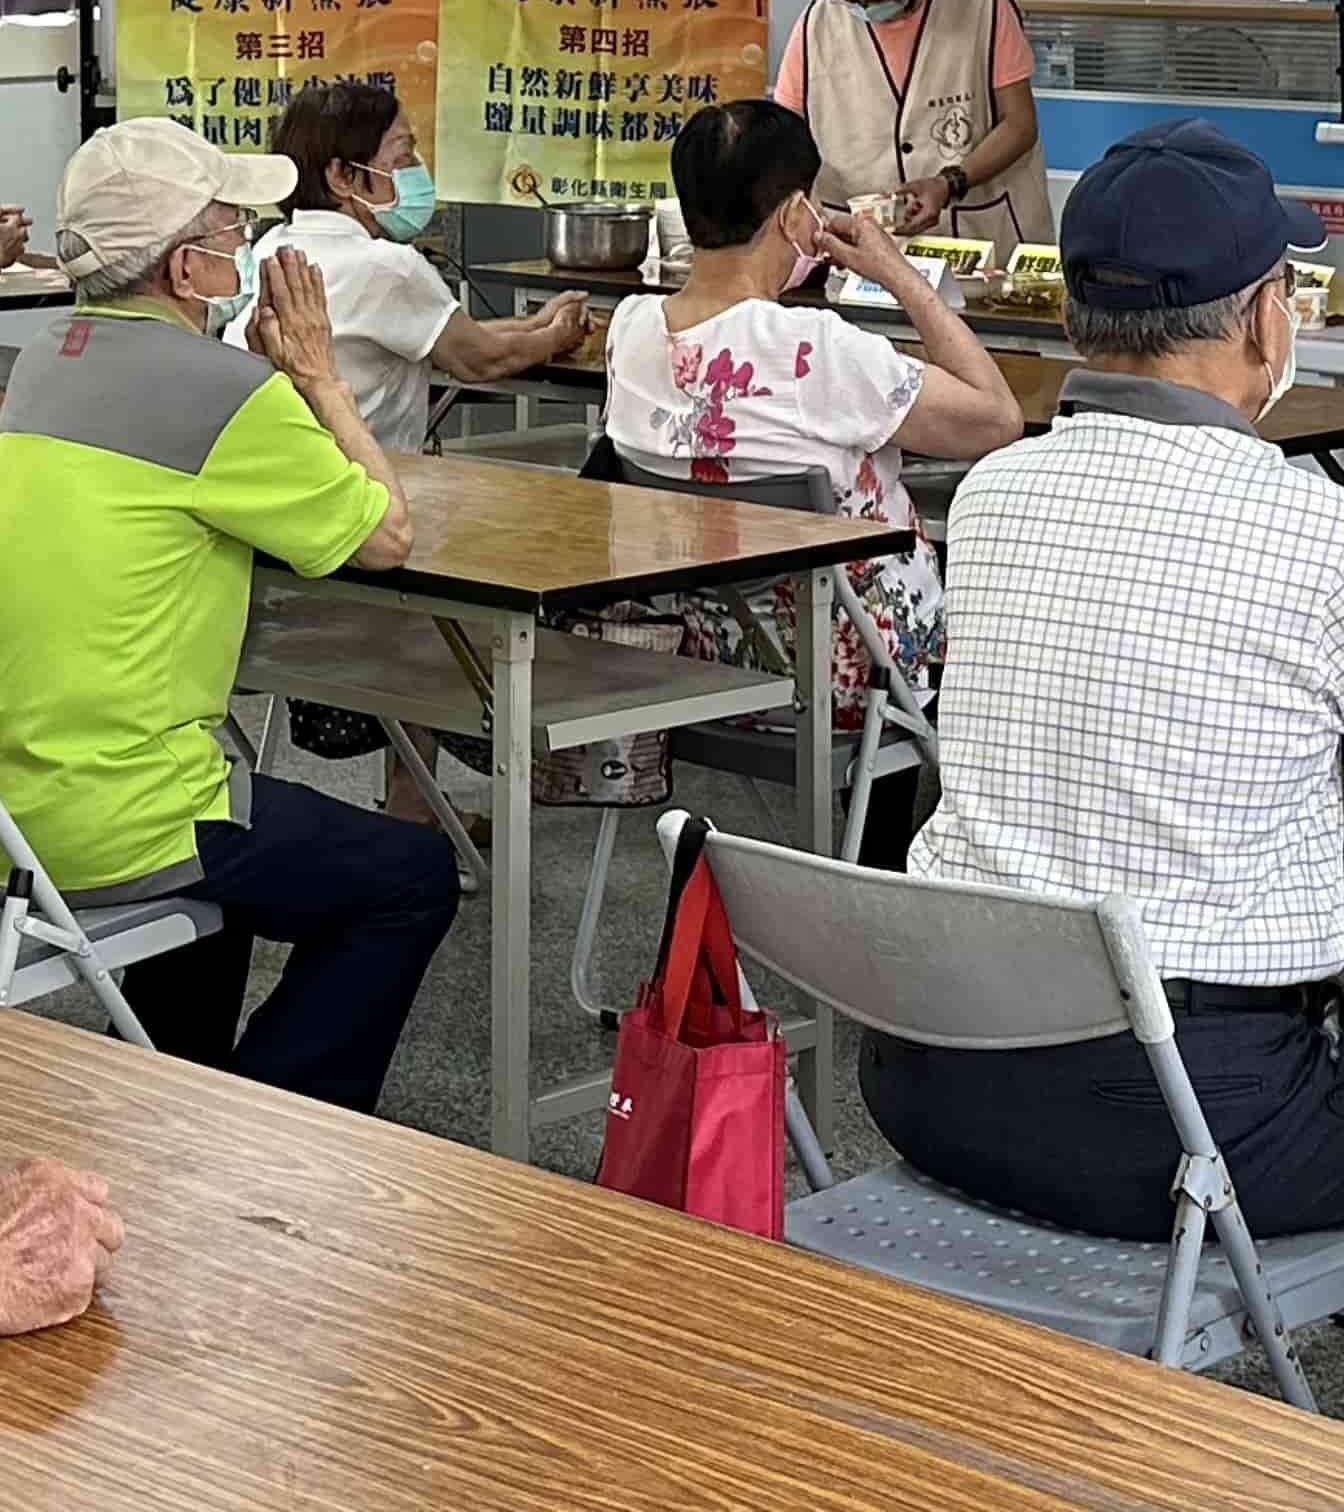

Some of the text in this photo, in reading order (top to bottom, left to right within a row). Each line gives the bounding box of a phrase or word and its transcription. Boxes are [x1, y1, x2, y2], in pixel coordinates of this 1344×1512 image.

[235, 31, 326, 60] 第三招
[559, 24, 650, 58] 第四招
[488, 62, 721, 104] 自然新鮮享美味
[551, 176, 668, 200] 彰化縣衛生局
